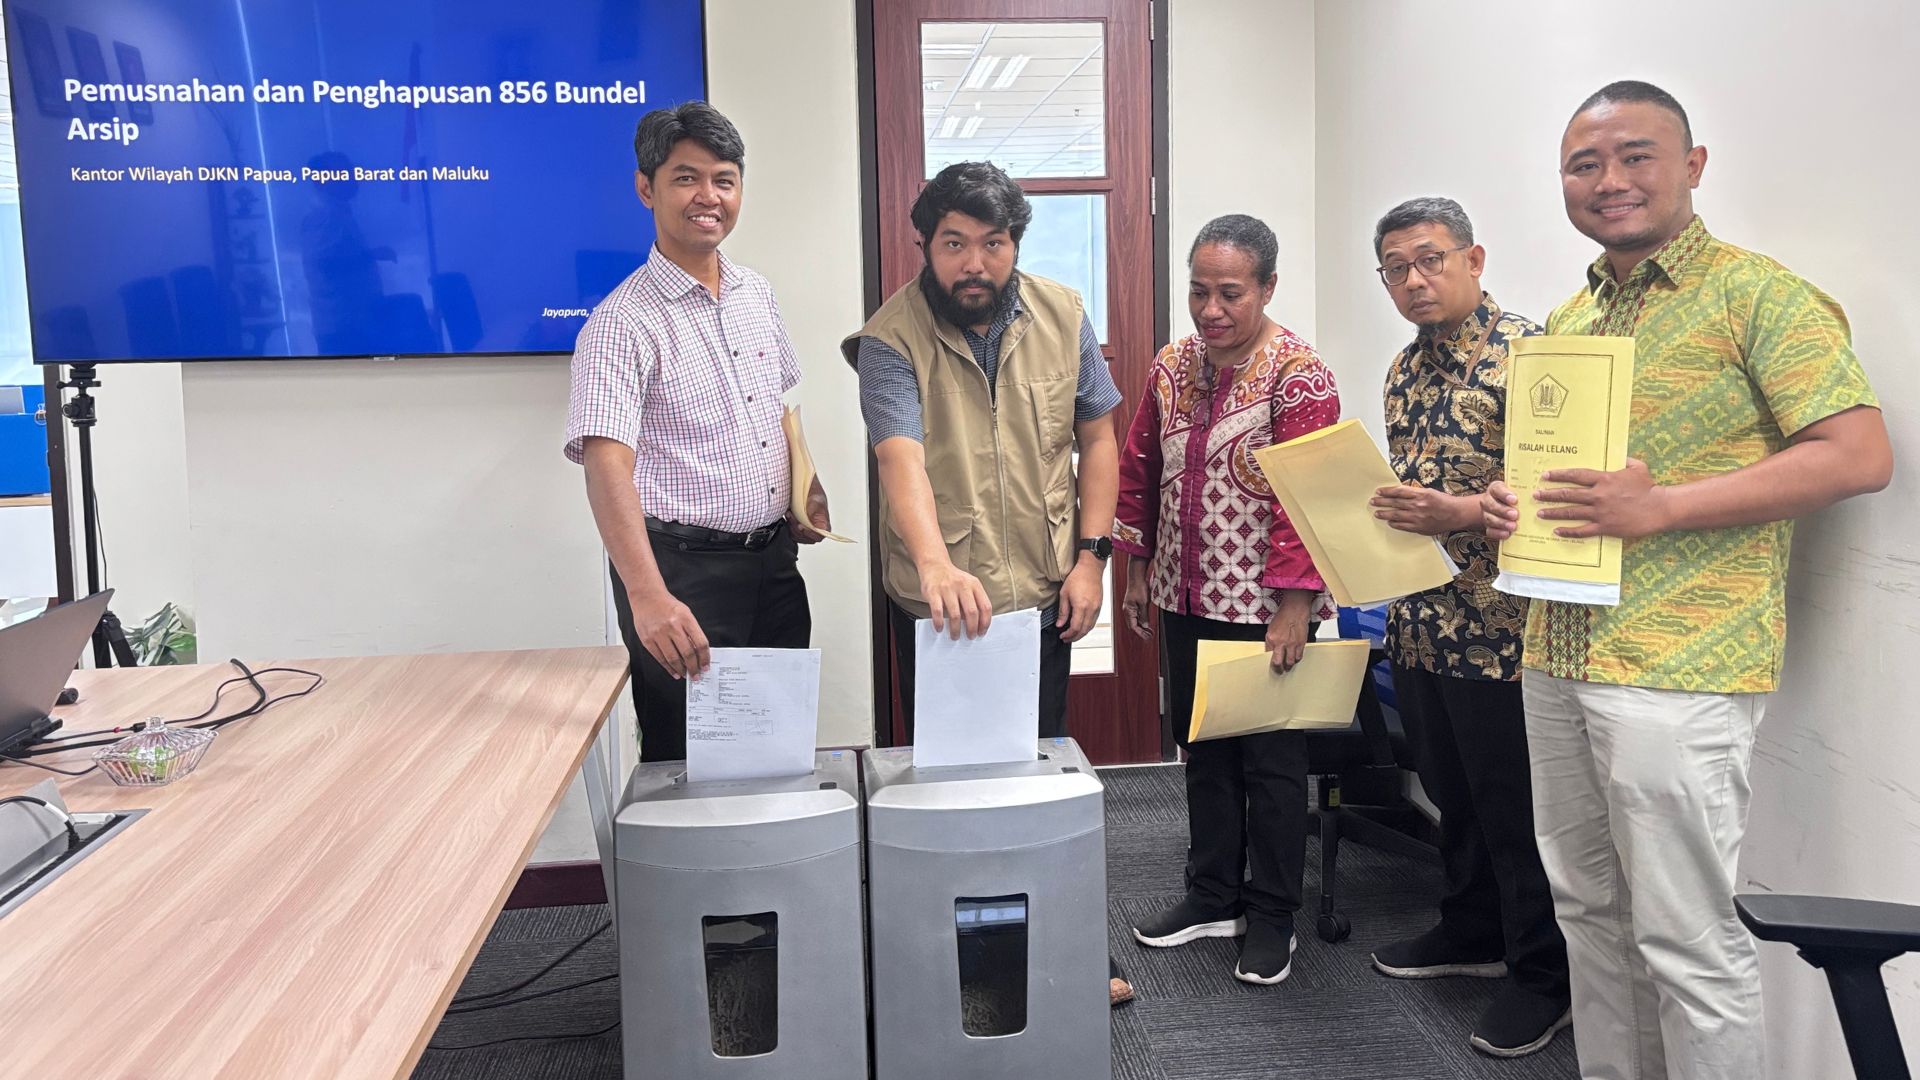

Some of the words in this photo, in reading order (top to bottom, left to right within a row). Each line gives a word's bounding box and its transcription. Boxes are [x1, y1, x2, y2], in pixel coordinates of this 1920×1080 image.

[64, 78, 245, 103] Pemusnahan
[252, 78, 305, 103] dan
[313, 80, 492, 109] Penghapusan
[499, 81, 548, 104] 856
[555, 80, 646, 104] Bundel
[67, 116, 140, 146] Arsip
[71, 166, 125, 181] Kantor
[129, 166, 194, 185] Wilayah
[197, 166, 239, 181] DJKN
[243, 166, 297, 185] Papua,
[301, 166, 350, 185] Papua
[354, 166, 395, 181] Barat
[398, 166, 428, 181] dan
[432, 165, 489, 181] Maluku
[542, 307, 590, 319] Jayapura,
[1518, 442, 1544, 452] RISALAH
[1546, 445, 1578, 455] LELANG
